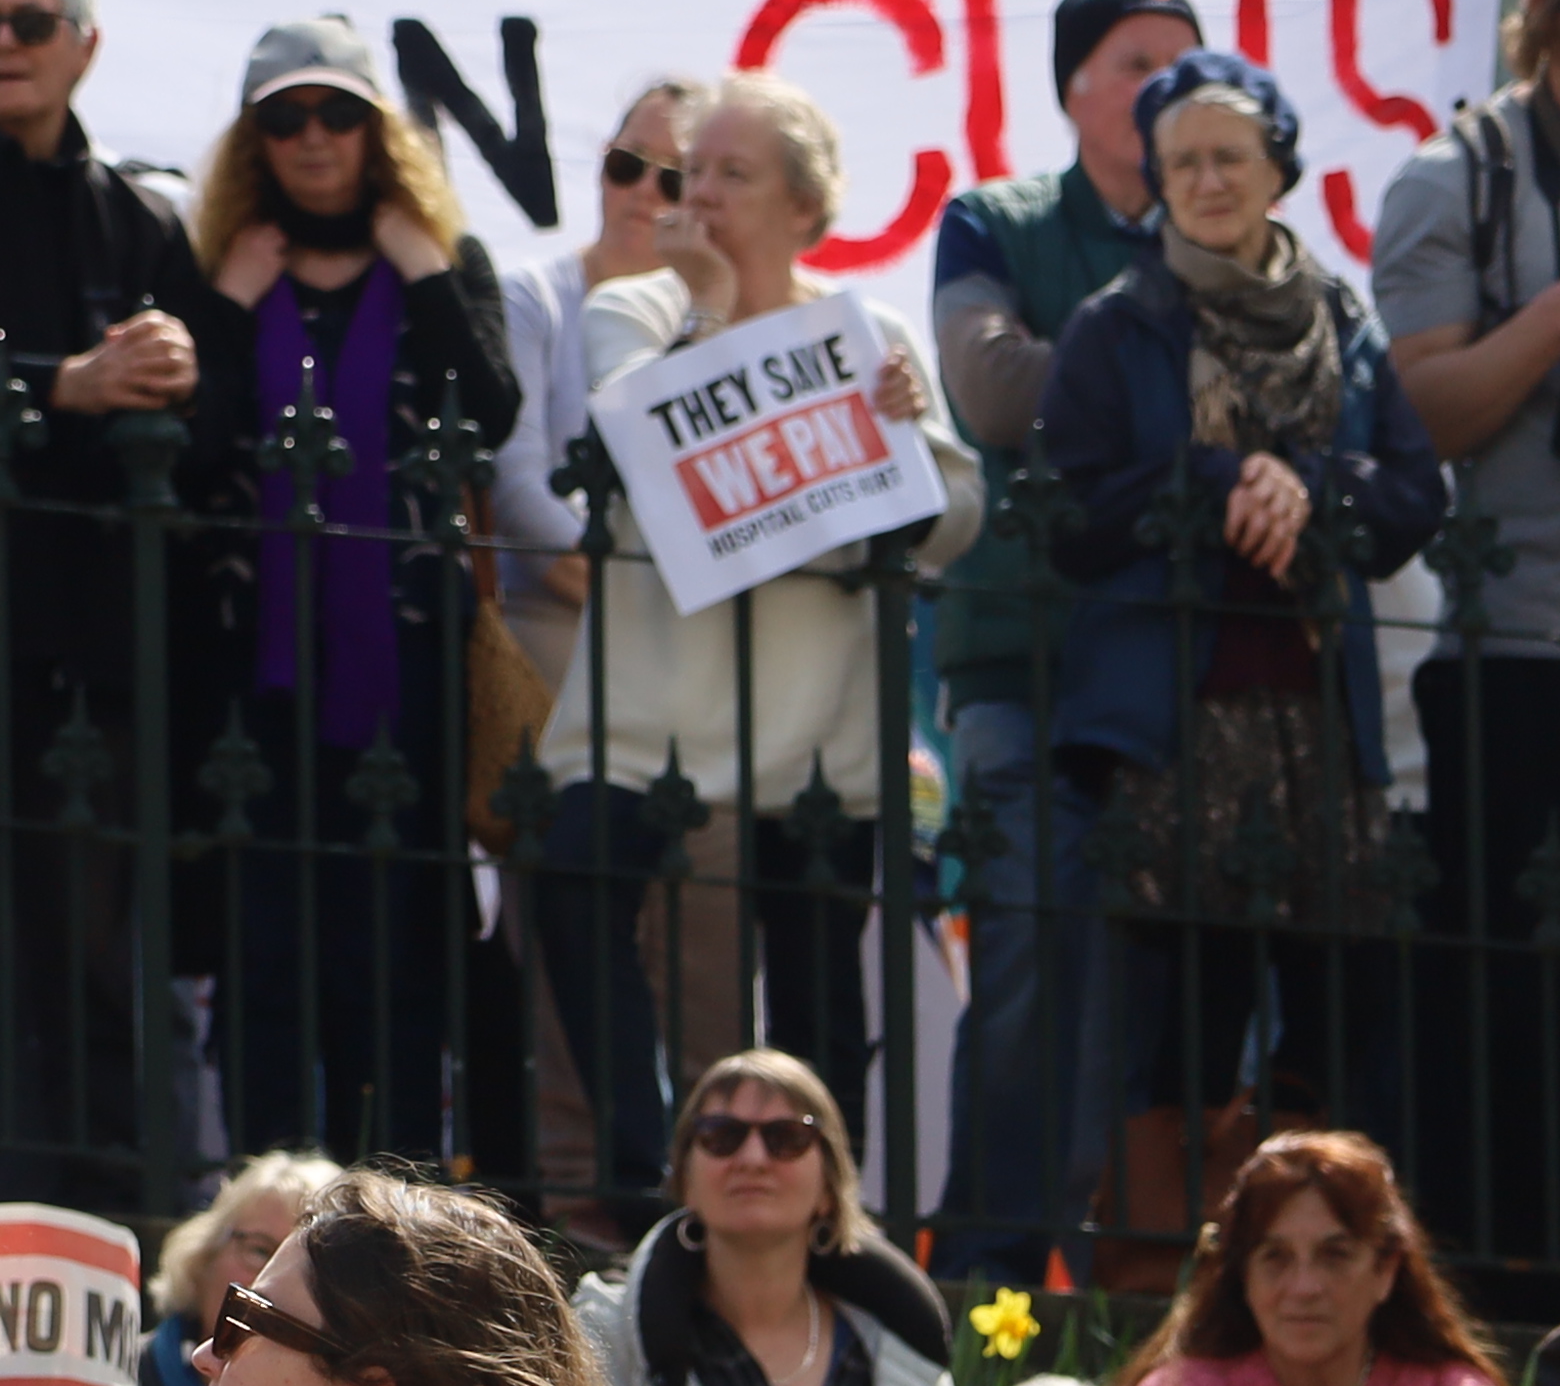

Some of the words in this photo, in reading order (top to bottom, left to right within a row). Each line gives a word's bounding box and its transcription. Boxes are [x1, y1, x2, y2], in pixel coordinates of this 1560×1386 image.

[358, 15, 560, 229] N
[650, 367, 759, 450] THEY
[760, 334, 854, 402] SAVE
[692, 428, 792, 515] WE
[782, 401, 868, 480] PAY
[708, 501, 808, 560] HOSPITAL
[808, 481, 857, 516] CUTS
